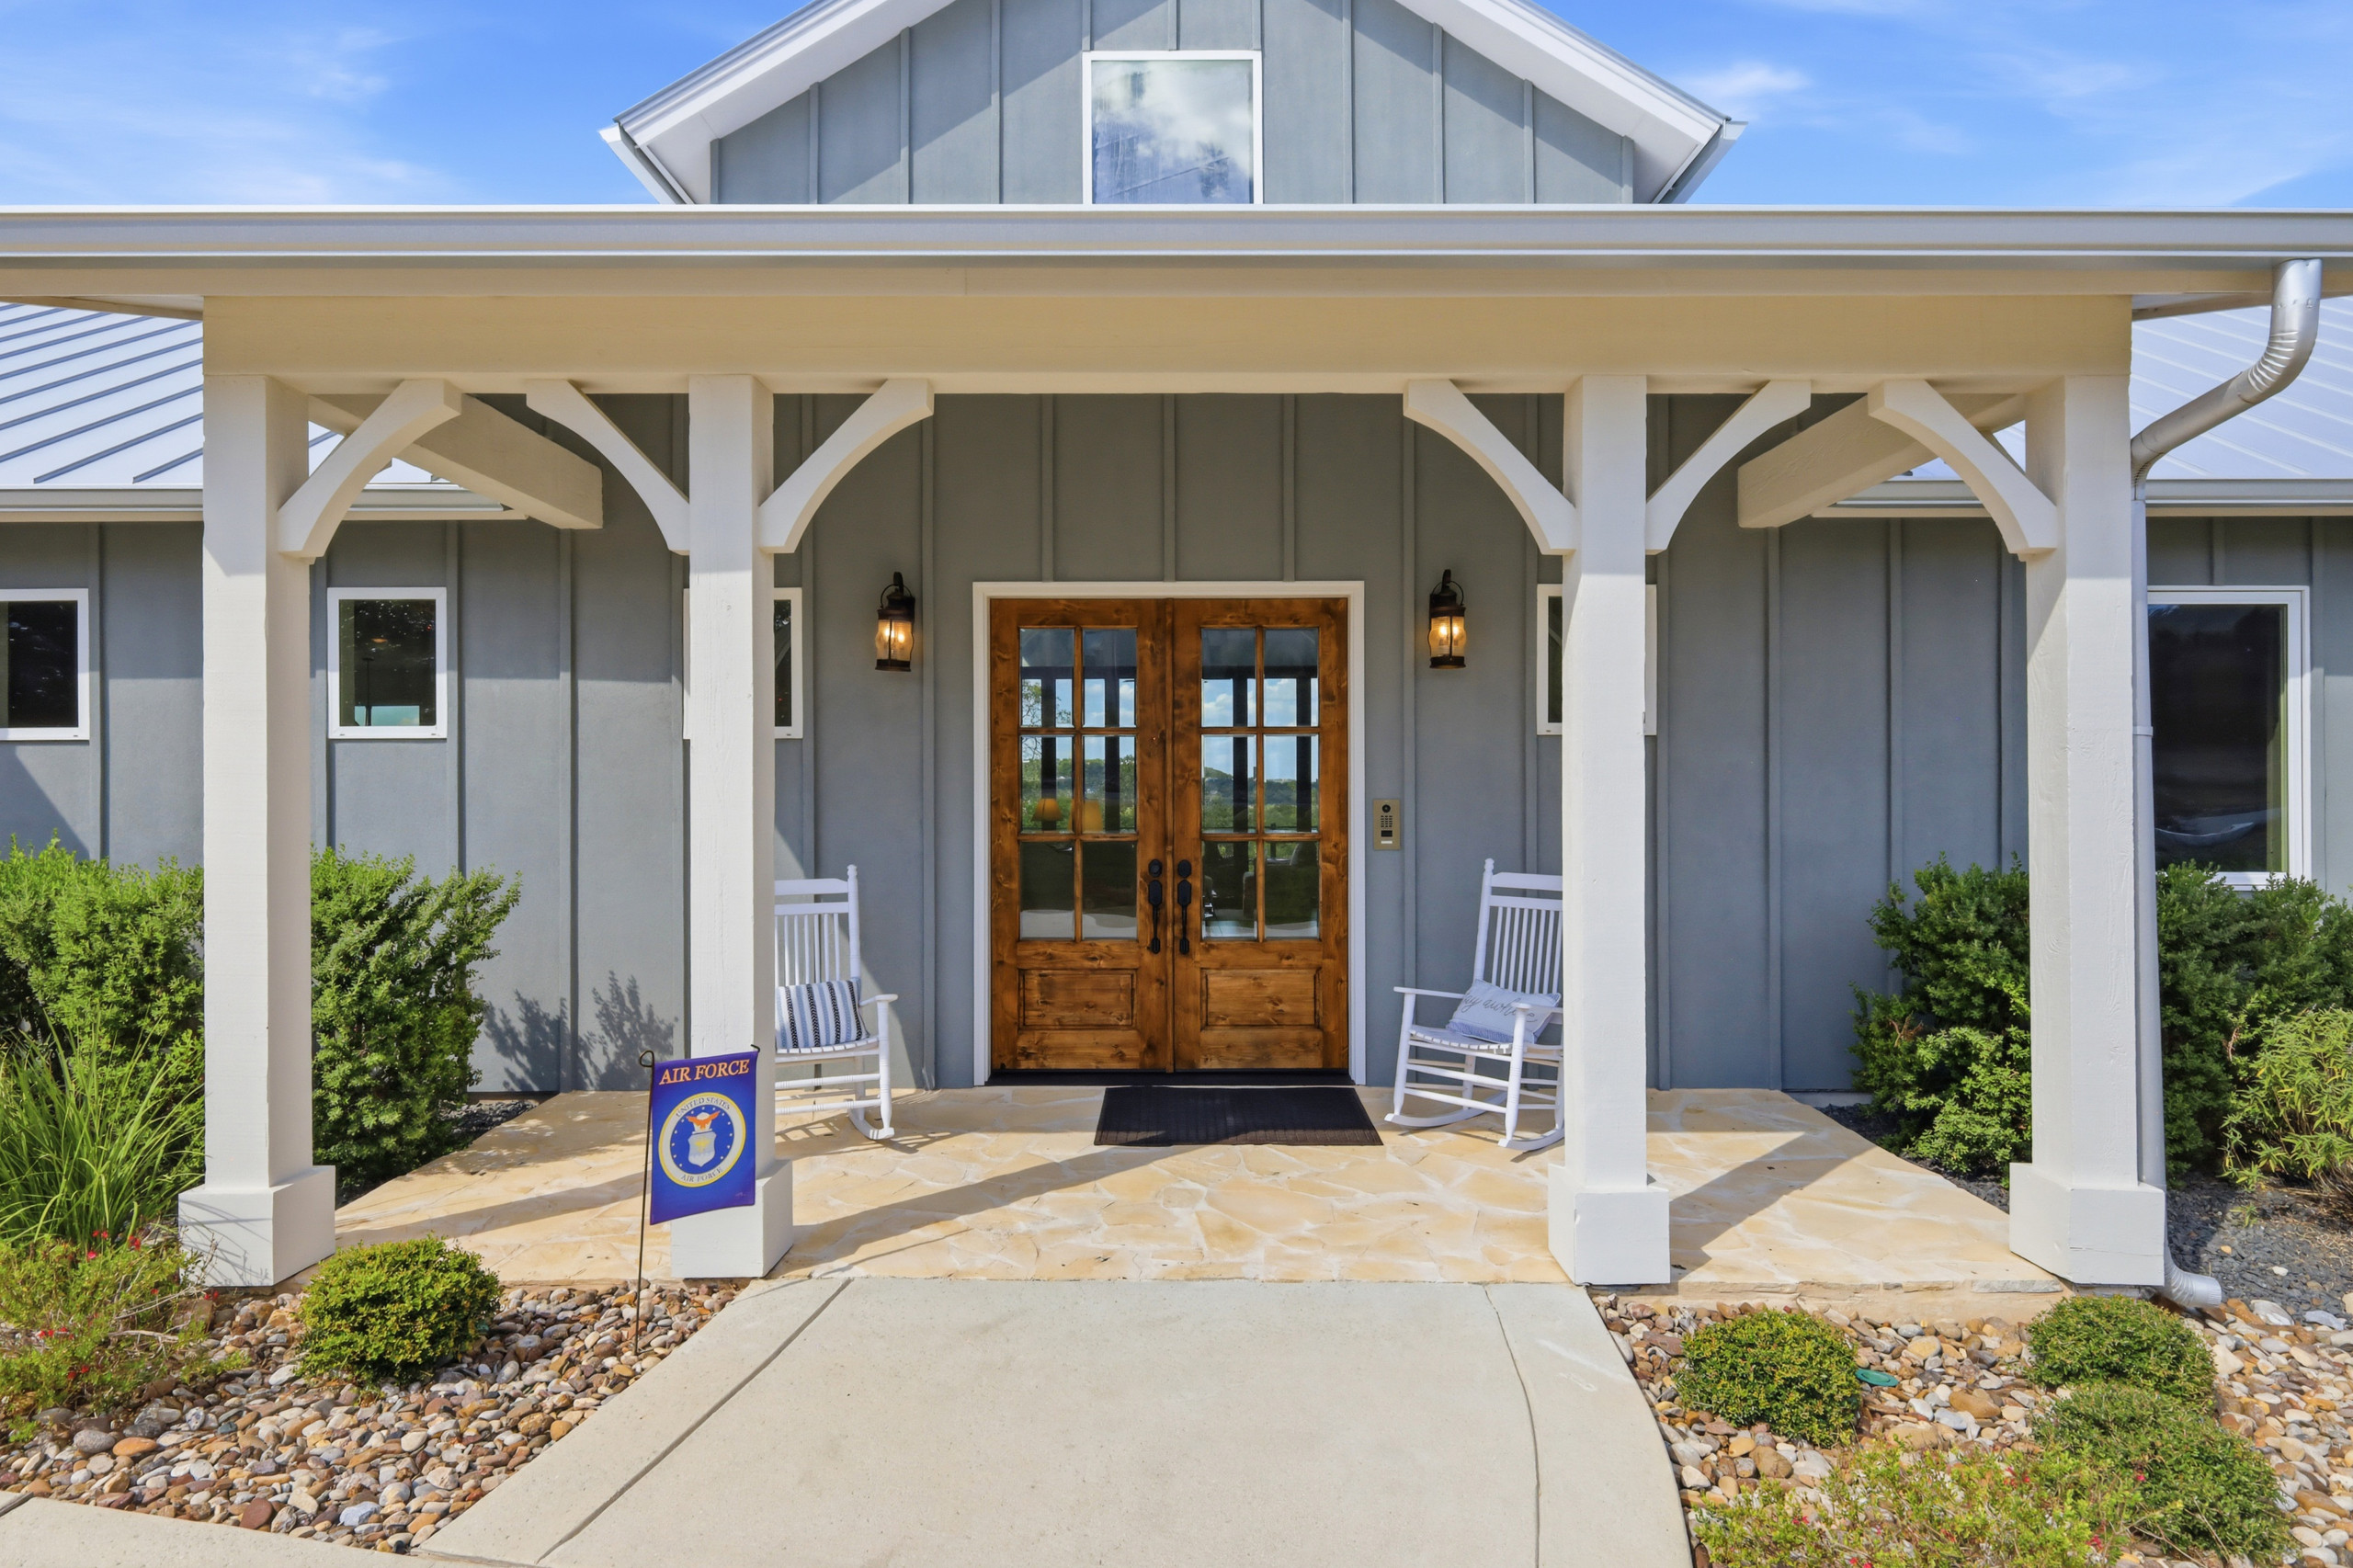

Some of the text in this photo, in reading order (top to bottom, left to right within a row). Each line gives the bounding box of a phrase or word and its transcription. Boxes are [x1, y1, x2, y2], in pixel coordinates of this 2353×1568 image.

[658, 1059, 750, 1085] AIR FORCE
[676, 1096, 731, 1118] UNITED STATES
[680, 1167, 722, 1183] AIR FORCE
